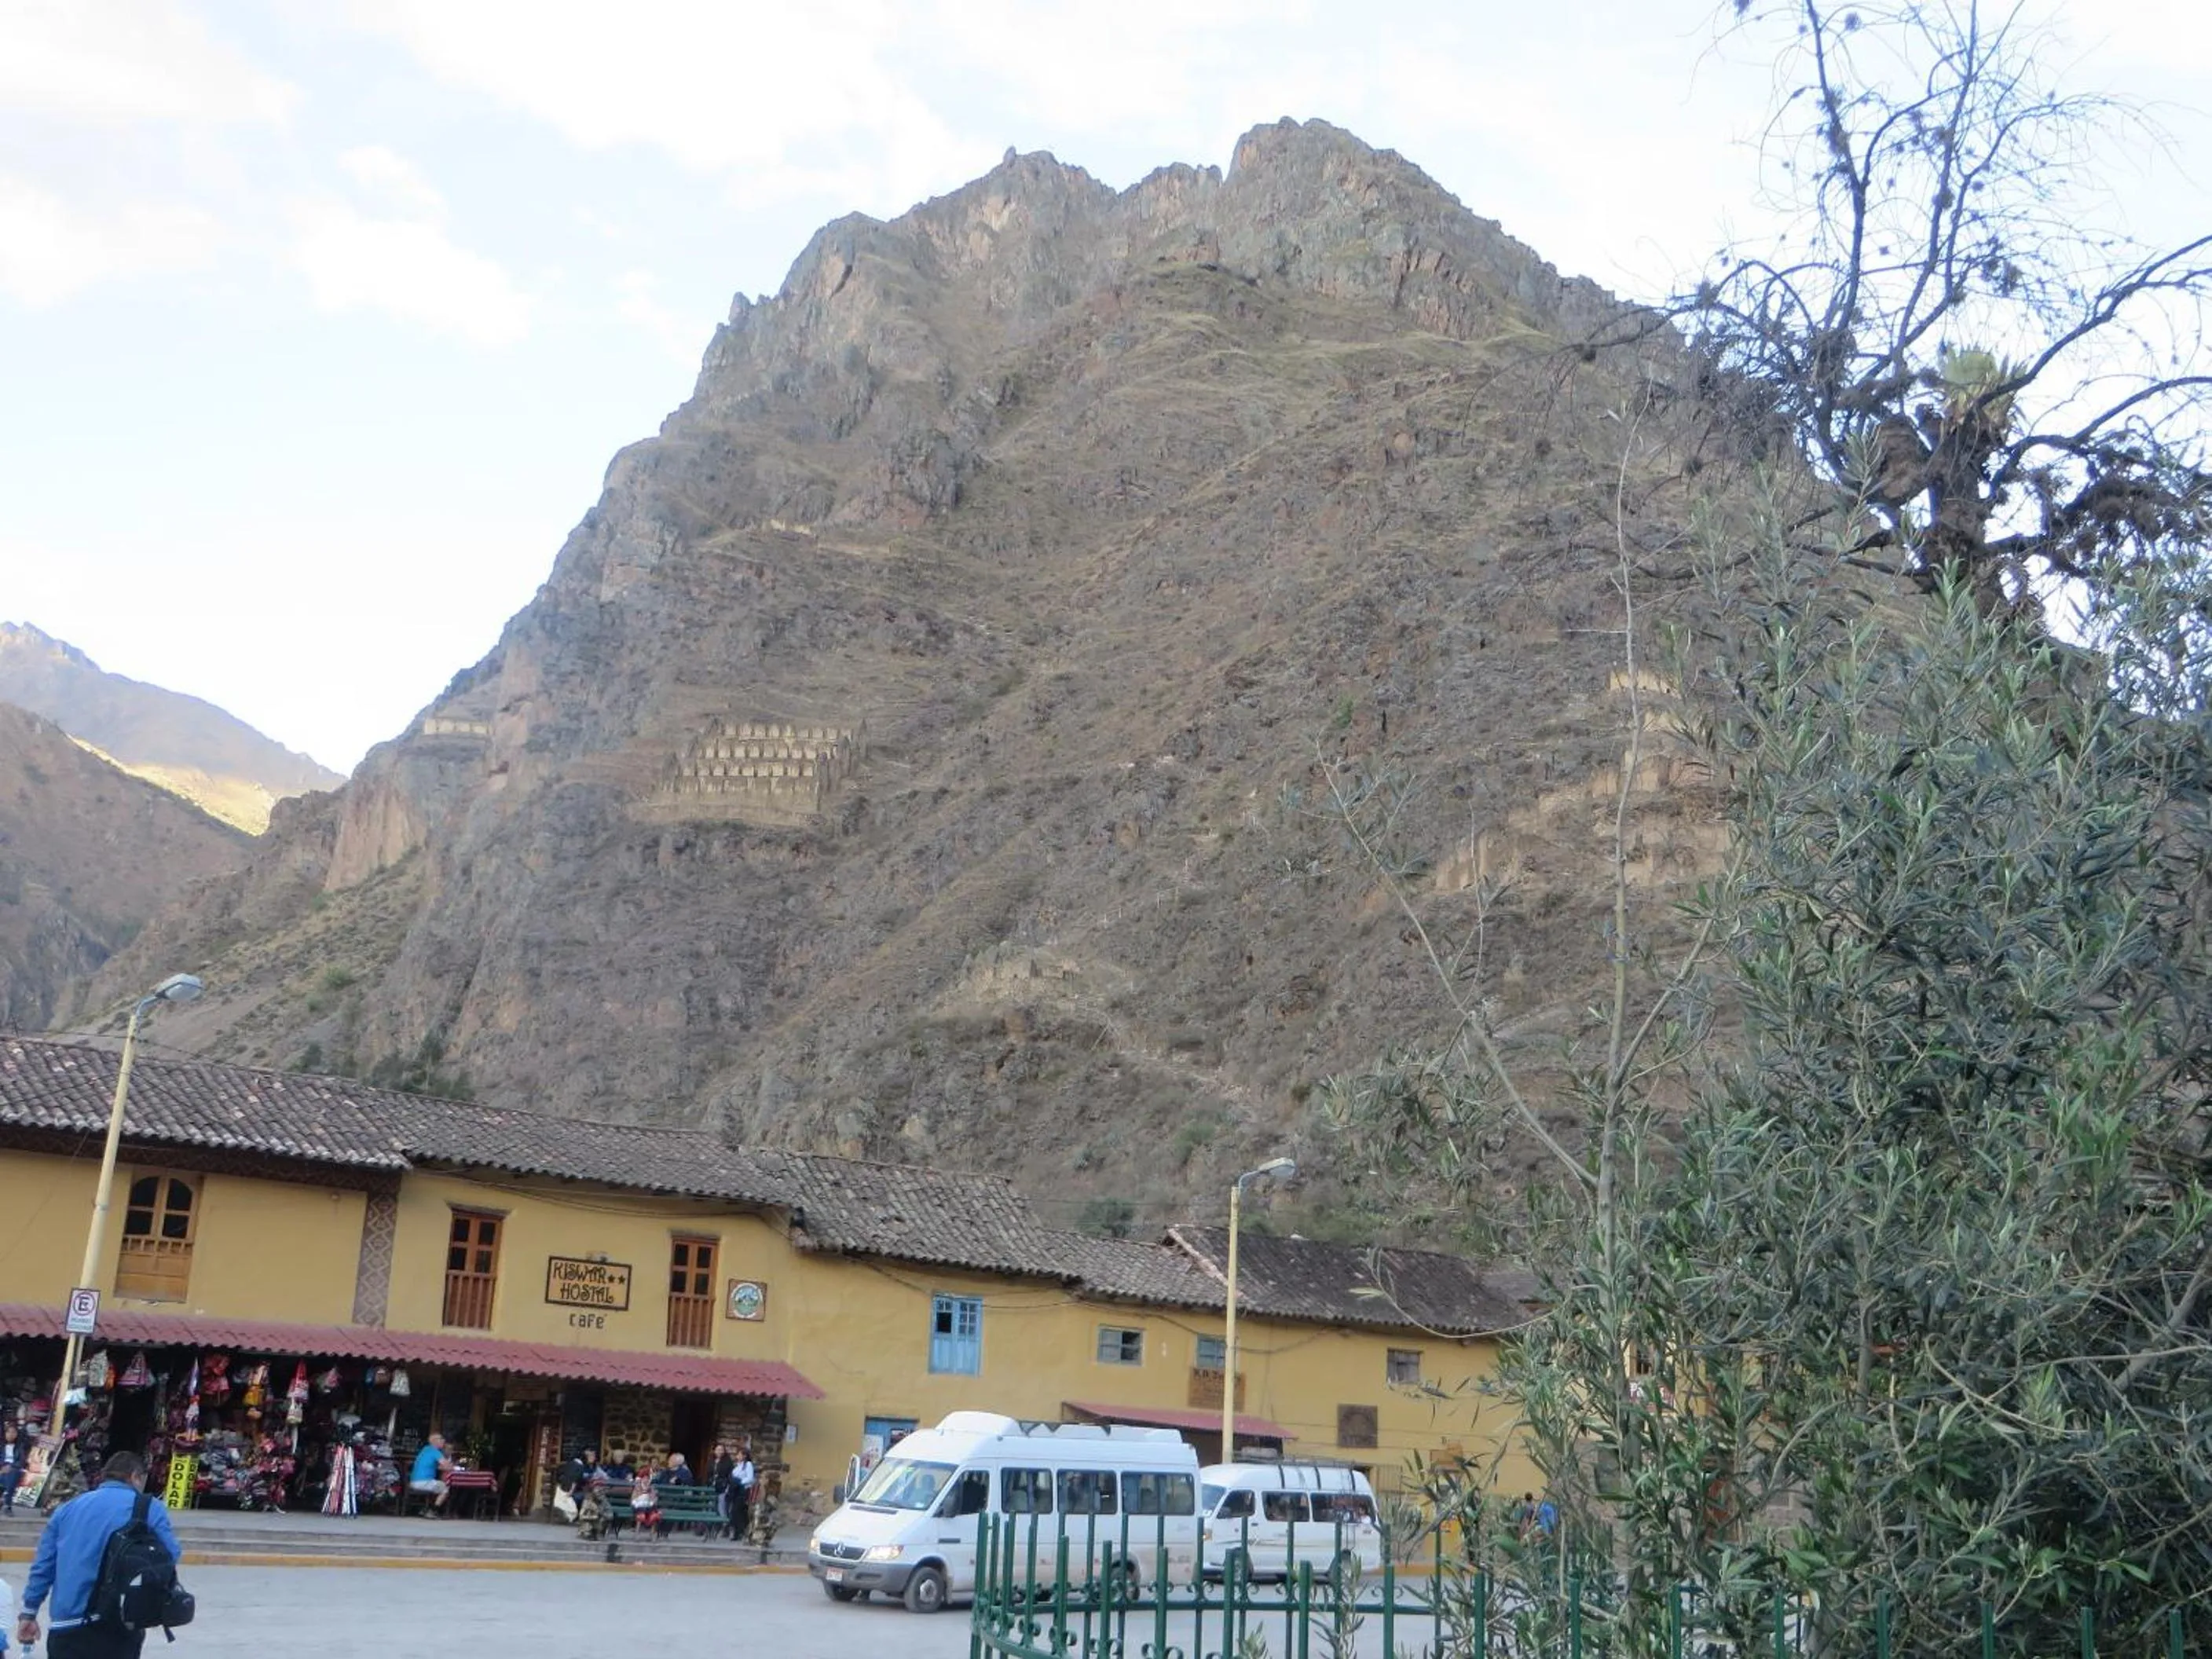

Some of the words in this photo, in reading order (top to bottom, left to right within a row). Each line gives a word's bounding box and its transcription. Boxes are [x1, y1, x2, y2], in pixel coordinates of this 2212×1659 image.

[79, 1296, 90, 1312] E
[560, 1283, 614, 1304] HOSTAL
[168, 1463, 185, 1507] DOLAR
